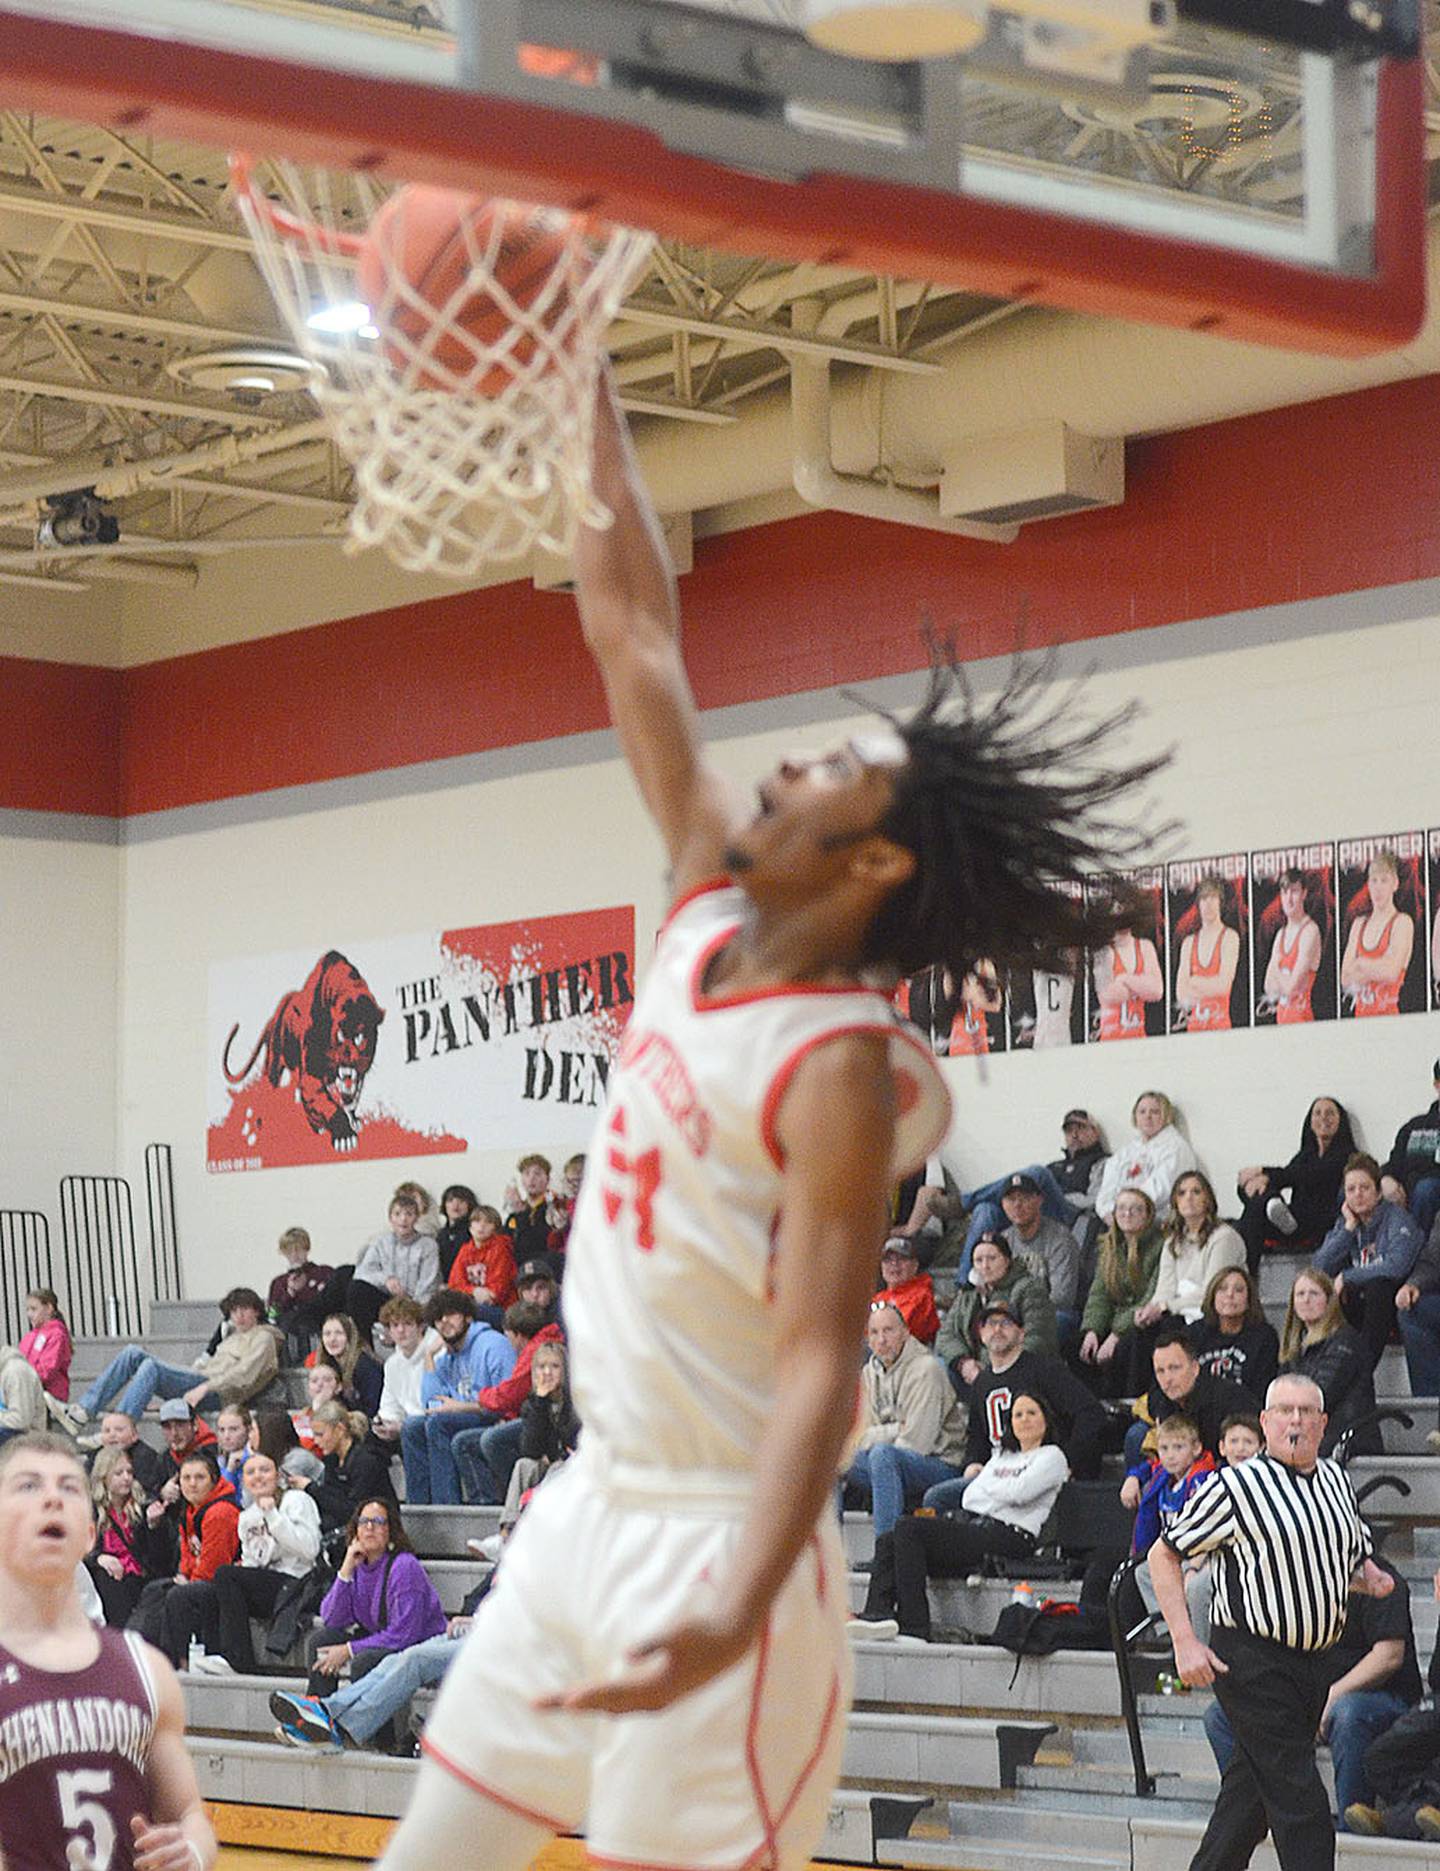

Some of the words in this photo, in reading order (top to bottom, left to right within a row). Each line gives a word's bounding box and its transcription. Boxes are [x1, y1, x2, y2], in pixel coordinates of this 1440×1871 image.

[396, 976, 442, 1010] THE
[402, 951, 636, 1064] PANTHER
[522, 1048, 609, 1107] DEN
[56, 1768, 118, 1871] 5
